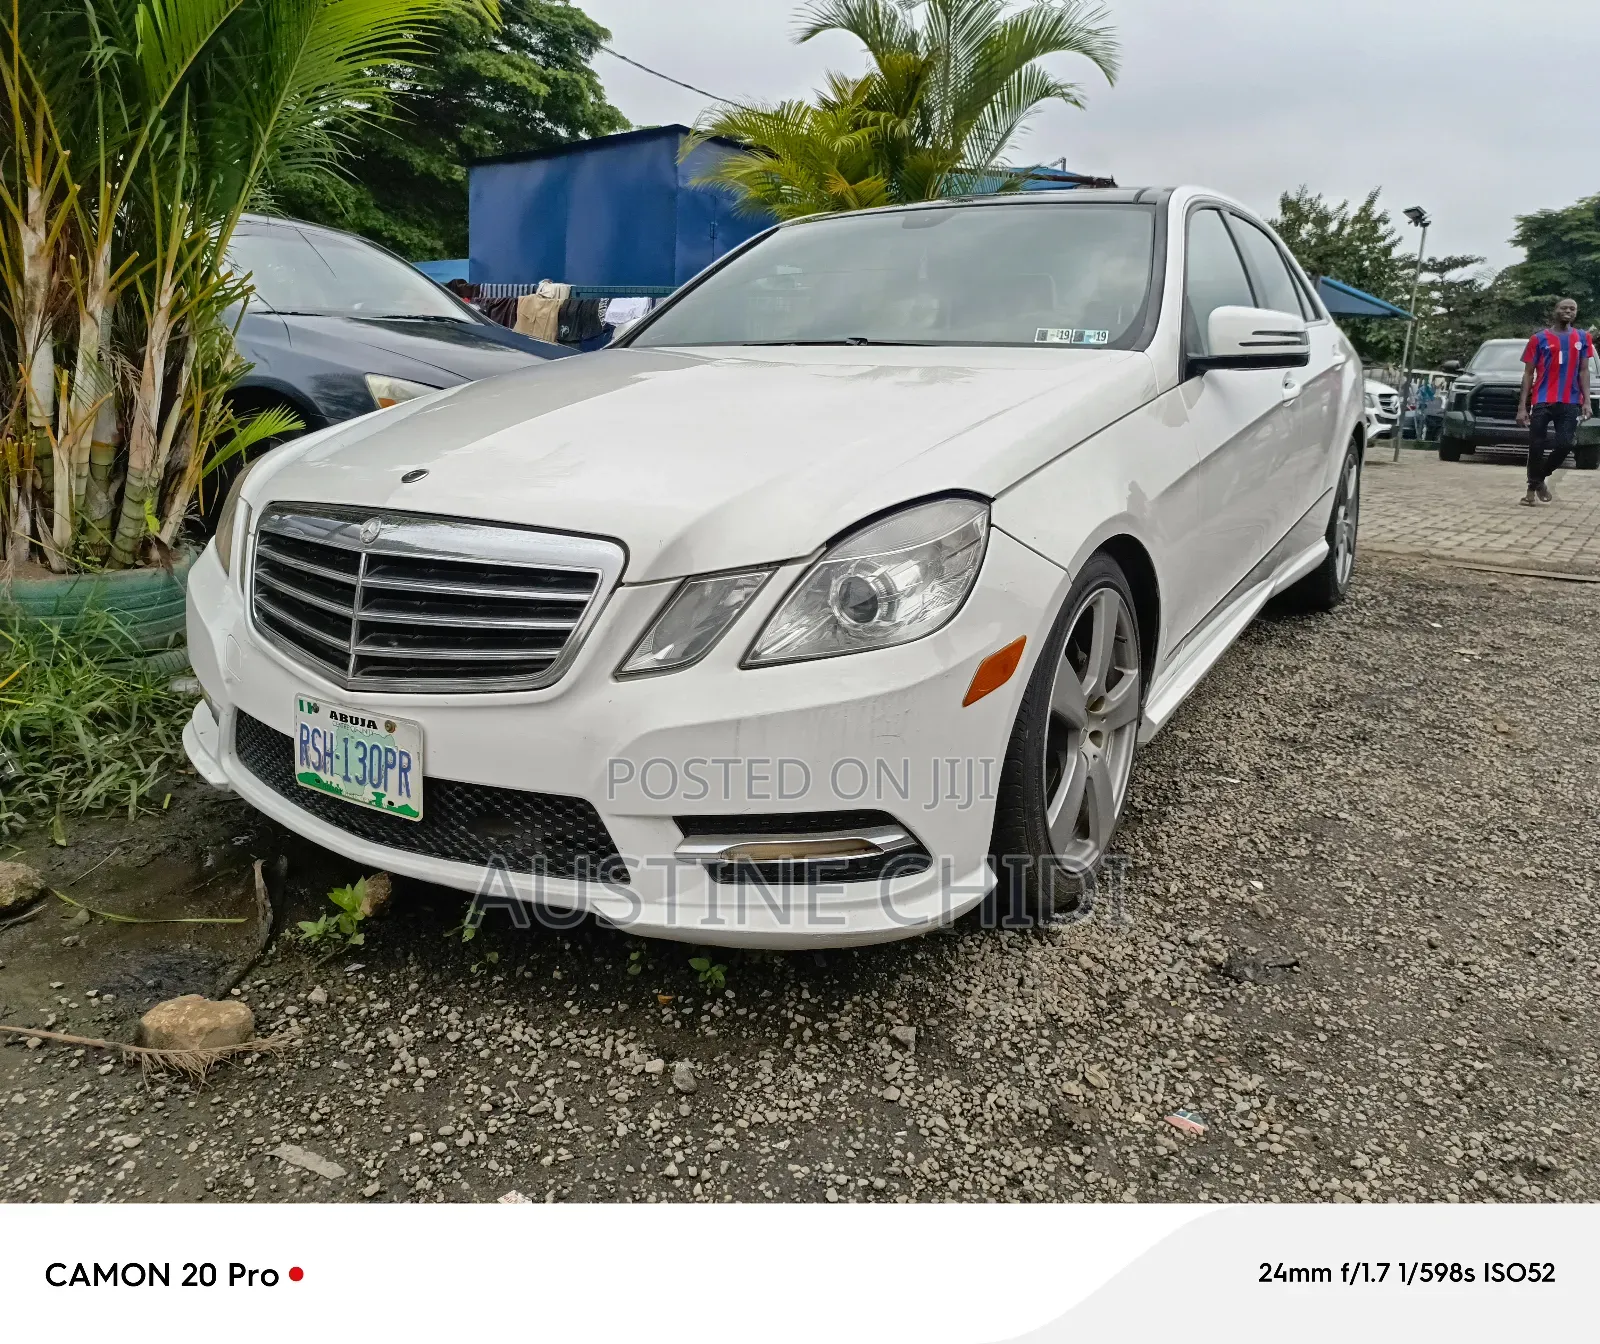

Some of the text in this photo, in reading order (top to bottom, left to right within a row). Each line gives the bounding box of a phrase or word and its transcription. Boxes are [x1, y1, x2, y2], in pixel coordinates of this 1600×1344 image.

[1058, 330, 1070, 340] 19
[1095, 331, 1107, 342] 19
[330, 710, 379, 730] ABUJA
[300, 721, 412, 799] RSH-130PR
